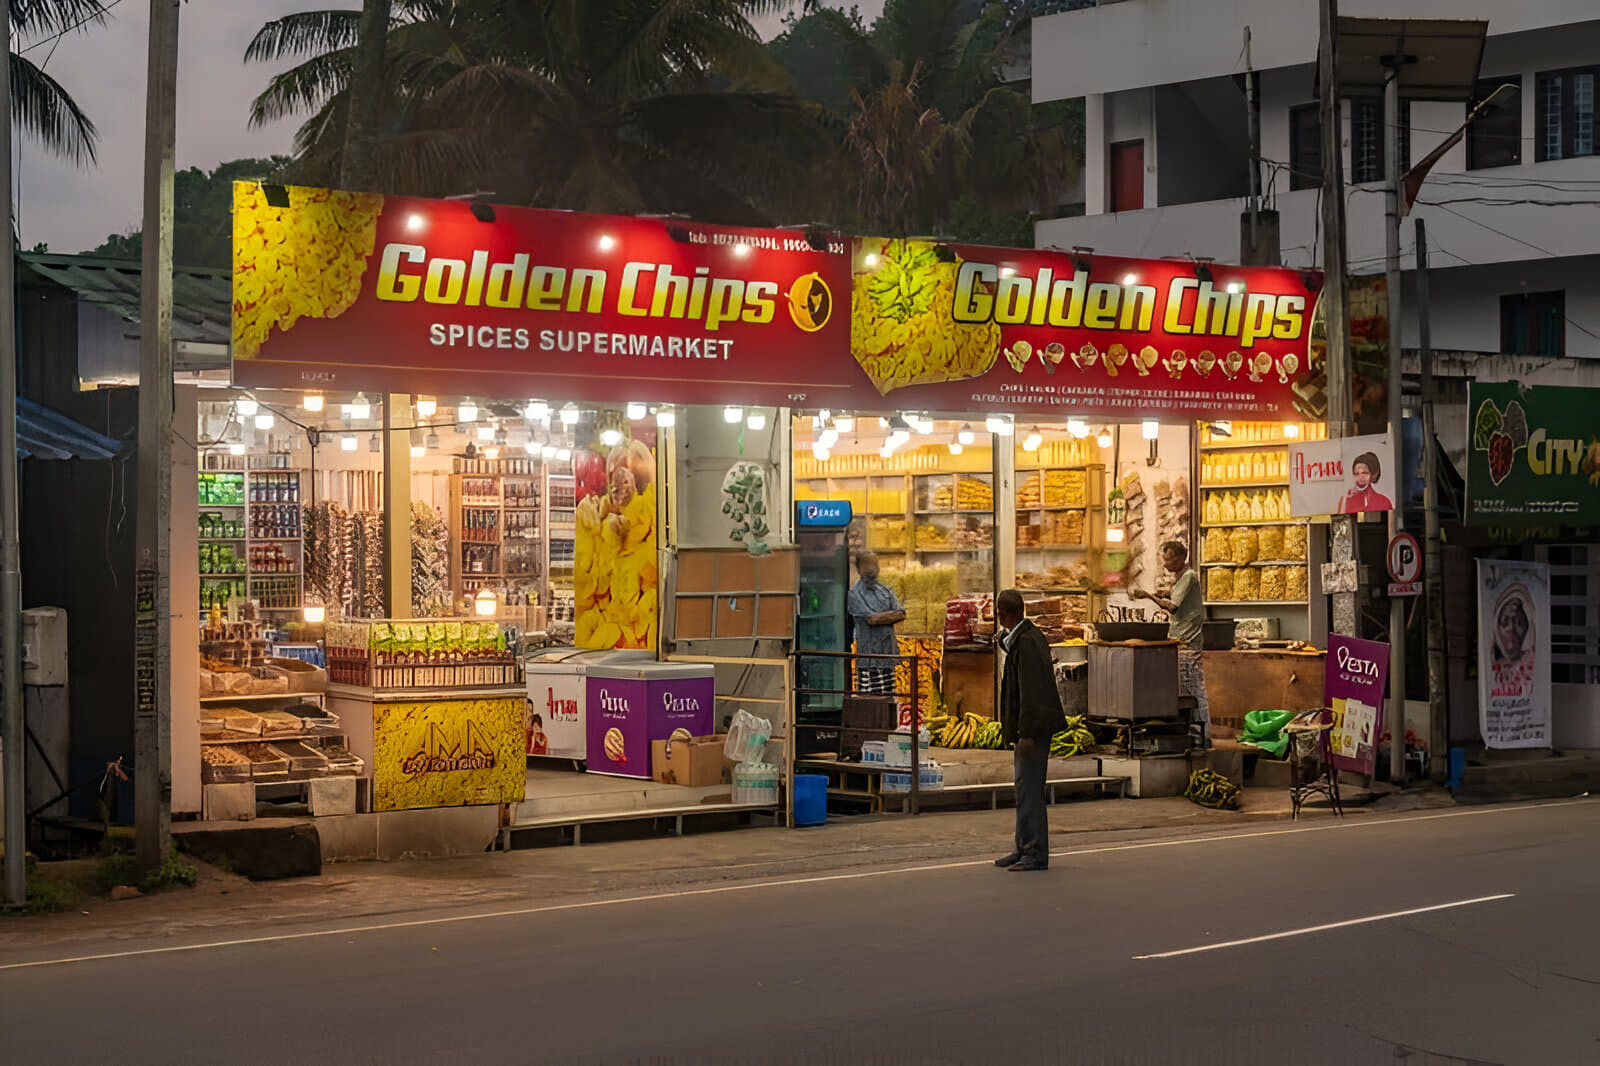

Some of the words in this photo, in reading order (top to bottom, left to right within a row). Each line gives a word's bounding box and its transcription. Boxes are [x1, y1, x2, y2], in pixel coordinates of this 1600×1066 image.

[375, 242, 608, 315] Golden
[617, 261, 779, 331] Chips
[951, 260, 1158, 333] Golden
[1162, 275, 1306, 349] Chips
[428, 322, 530, 350] SPICES
[538, 329, 735, 361] SUPERMARKET
[1527, 427, 1584, 476] CITY
